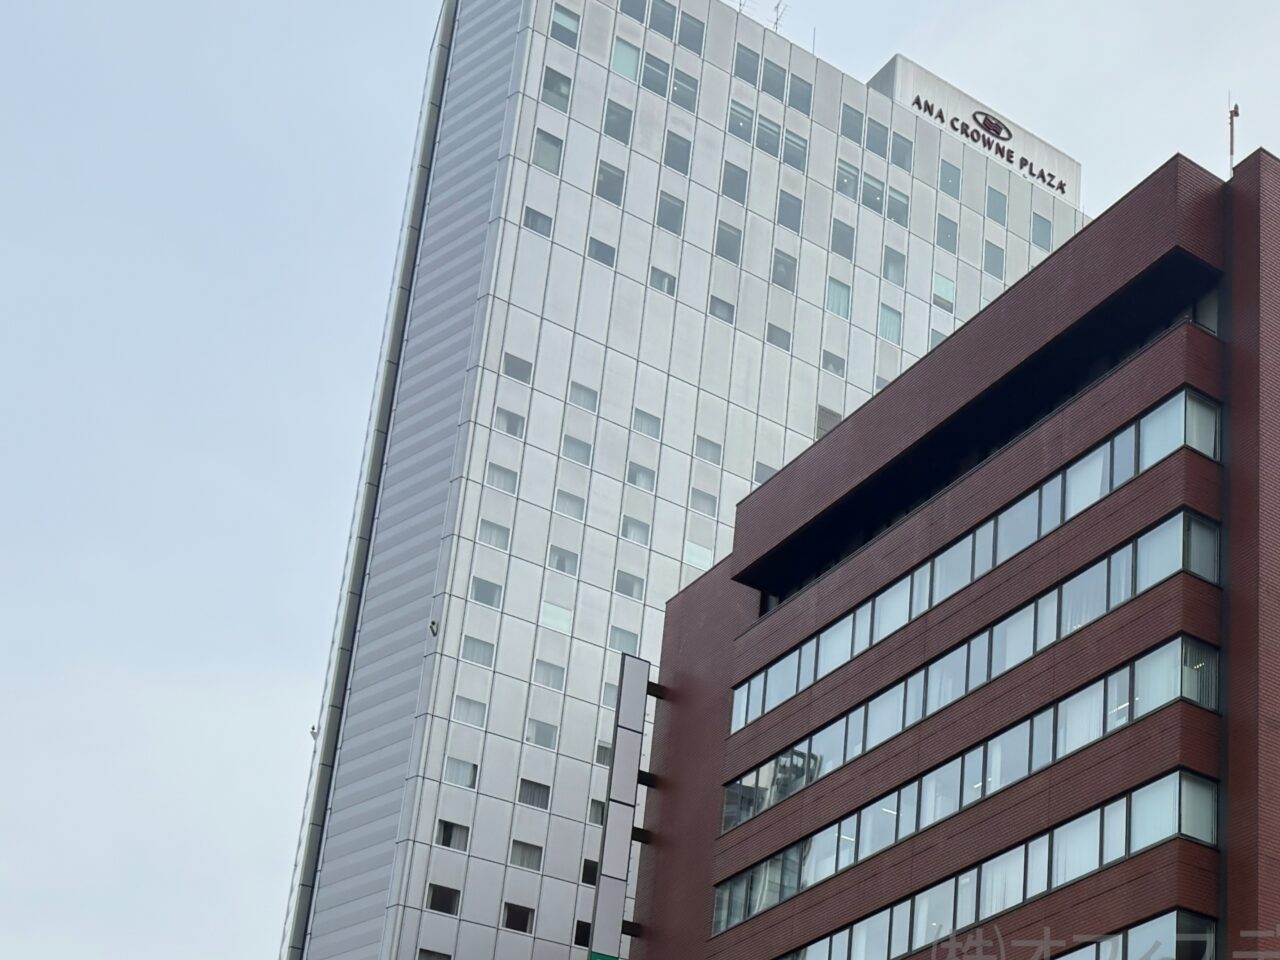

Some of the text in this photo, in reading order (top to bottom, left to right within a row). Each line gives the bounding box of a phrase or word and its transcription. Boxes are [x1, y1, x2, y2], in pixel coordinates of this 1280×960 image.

[912, 94, 1067, 194] ANA CROWNE PLAZA
